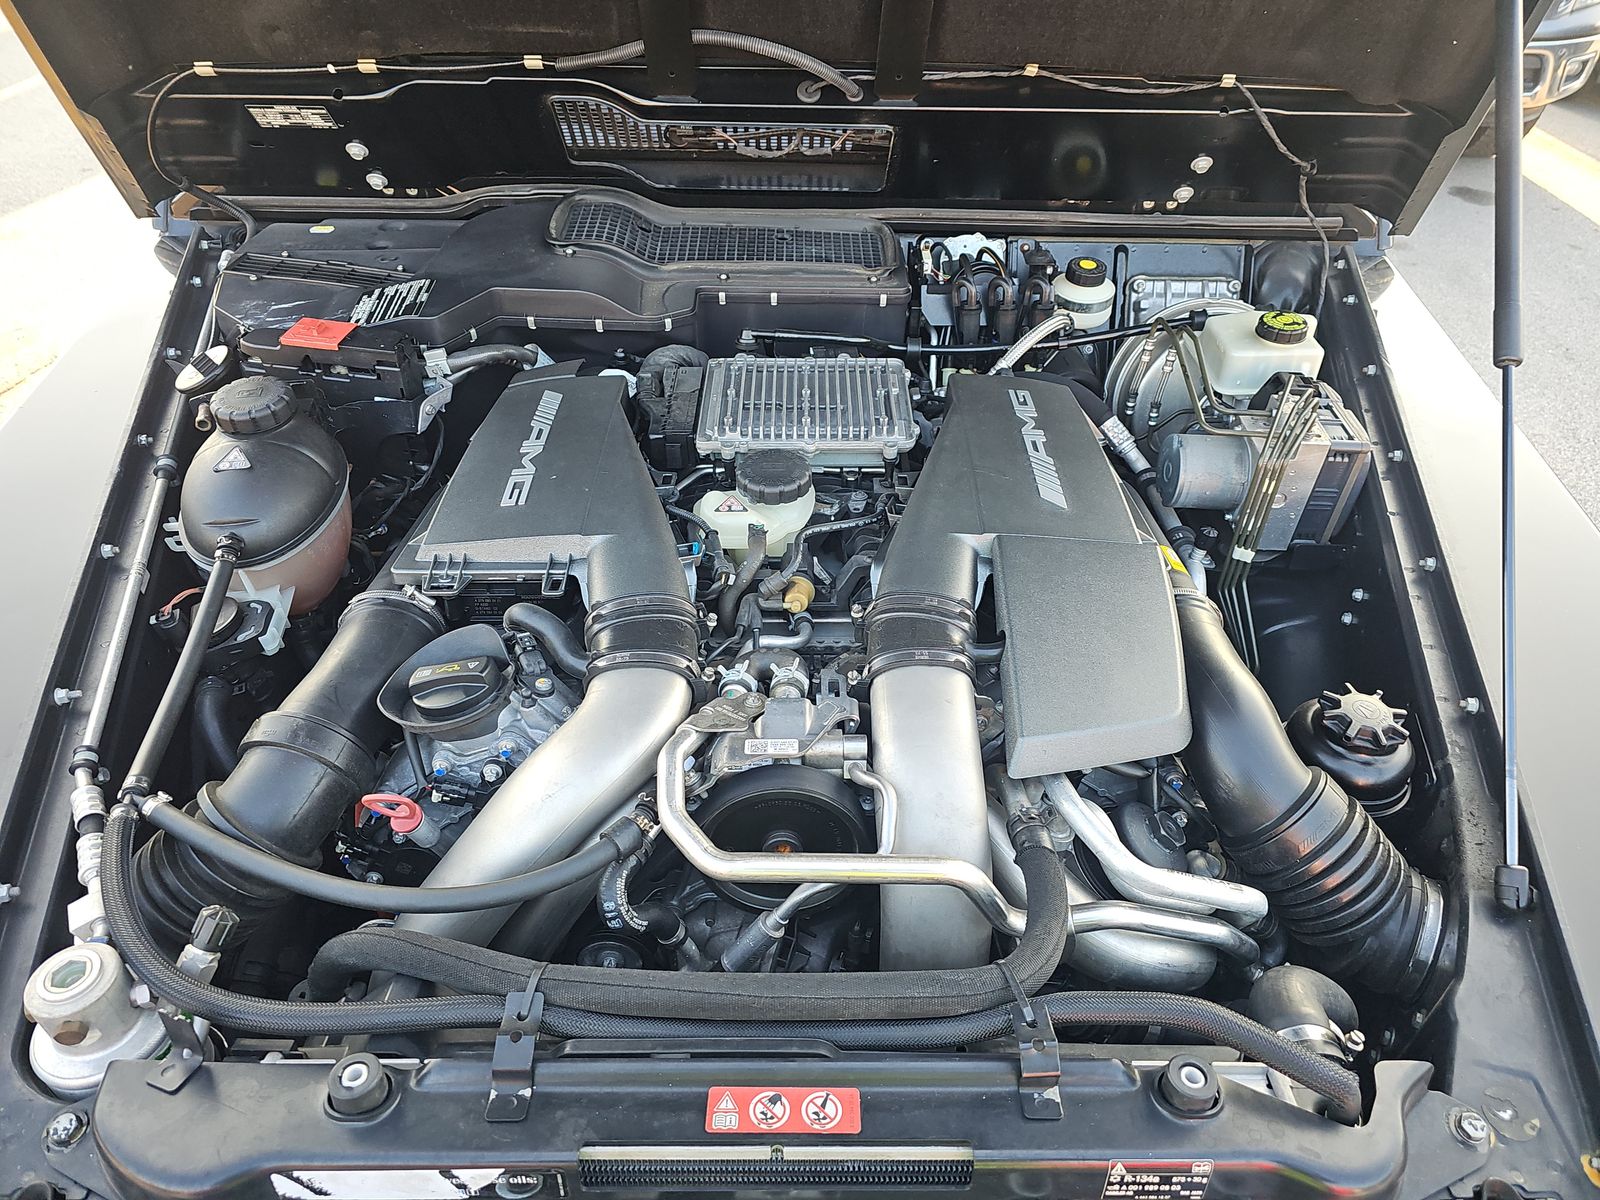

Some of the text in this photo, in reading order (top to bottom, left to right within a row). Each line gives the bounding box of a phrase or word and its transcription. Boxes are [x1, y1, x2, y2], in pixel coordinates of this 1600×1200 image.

[500, 418, 553, 507] AMG
[1008, 389, 1056, 469] AMG
[508, 1175, 538, 1184] oils:
